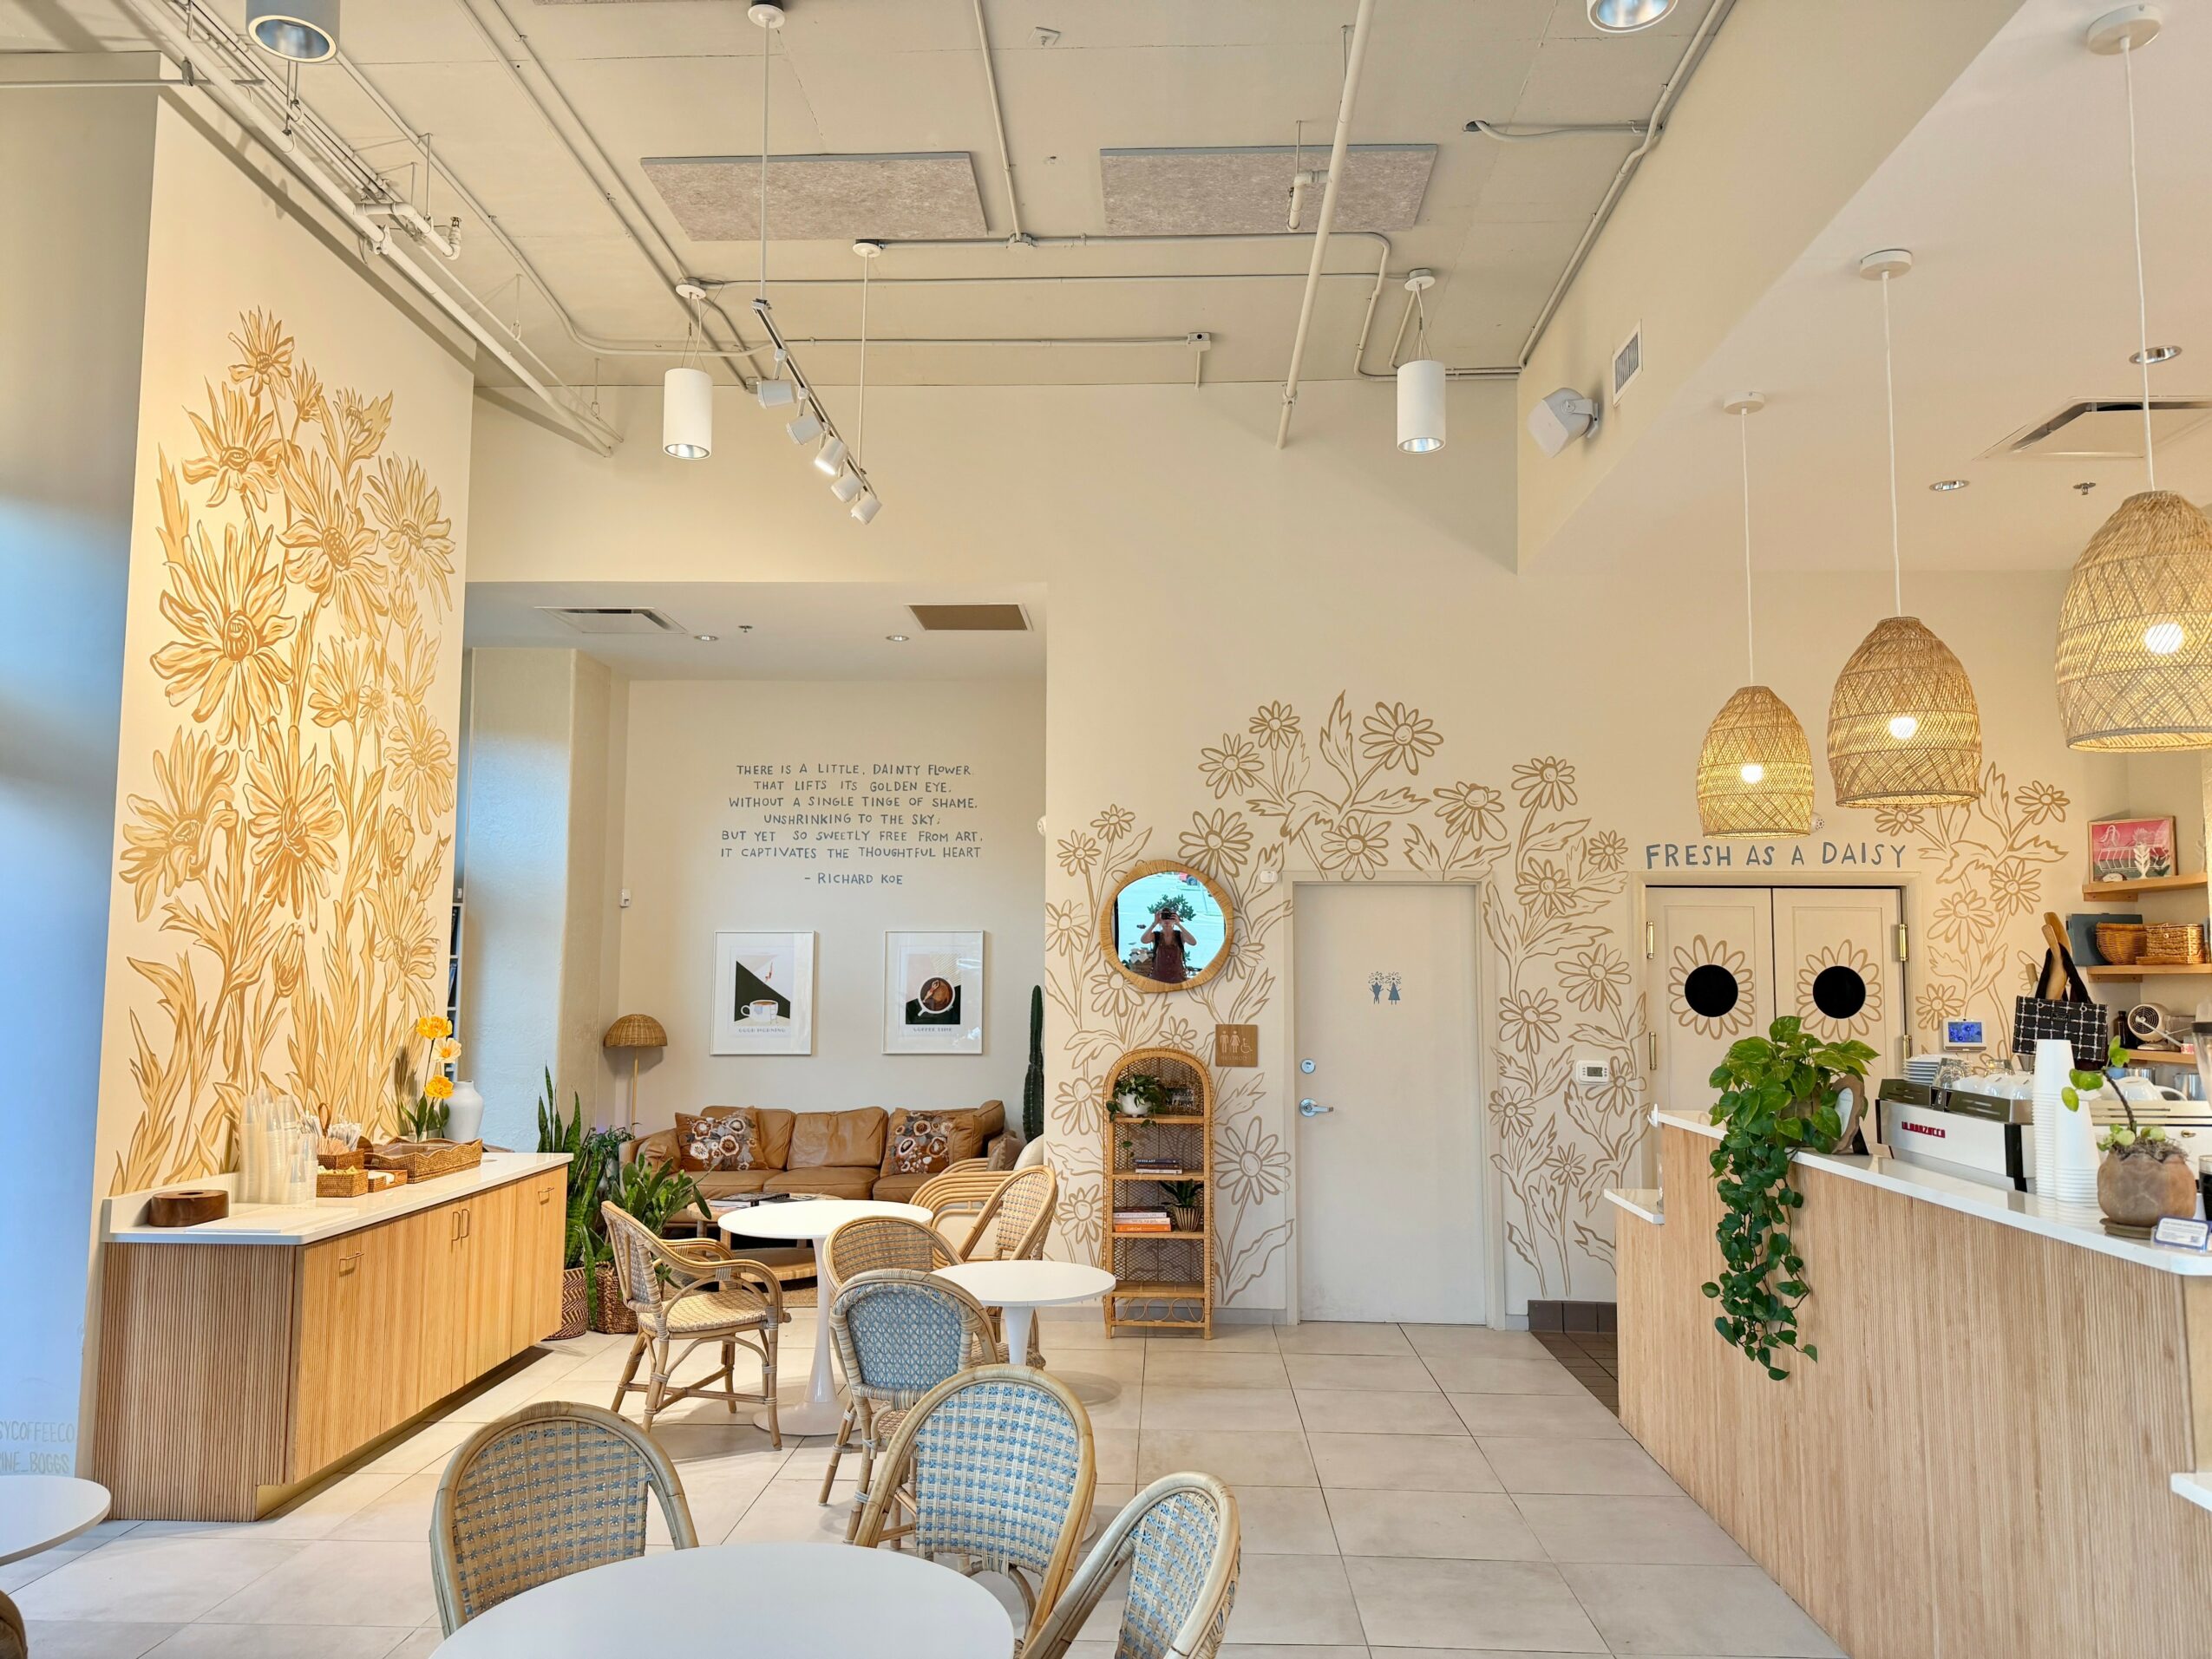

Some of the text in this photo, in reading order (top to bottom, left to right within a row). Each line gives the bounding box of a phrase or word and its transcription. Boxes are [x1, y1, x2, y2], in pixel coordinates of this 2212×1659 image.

[736, 765, 774, 775] THERE
[781, 765, 791, 774] IS
[799, 763, 808, 774] A
[873, 763, 921, 775] DAINTY
[928, 764, 972, 775] FLOWER
[753, 781, 784, 791] THAT
[795, 780, 827, 791] LIFTS
[841, 780, 858, 791] ITS
[870, 781, 918, 792] GOLDEN
[729, 797, 784, 807] WITHOUT
[793, 797, 801, 807] A
[808, 796, 854, 807] SINGLE
[861, 796, 900, 807] TINGE
[909, 797, 924, 806] OF
[763, 813, 852, 825] UNSHRINKING
[858, 813, 873, 824] TO
[880, 813, 904, 825] THE
[722, 830, 747, 840] BUT
[753, 831, 776, 841] YET
[793, 830, 808, 840] SO
[815, 830, 871, 841] SWEETLY
[880, 831, 907, 841] FREE
[919, 830, 949, 842] FROM
[721, 846, 982, 859] IT CAPTIVATES THE THOUGHTFUL HEART
[1646, 841, 1906, 869] FRESH AS A DAISY
[817, 872, 874, 885] RICHARD
[880, 873, 903, 885] KOE
